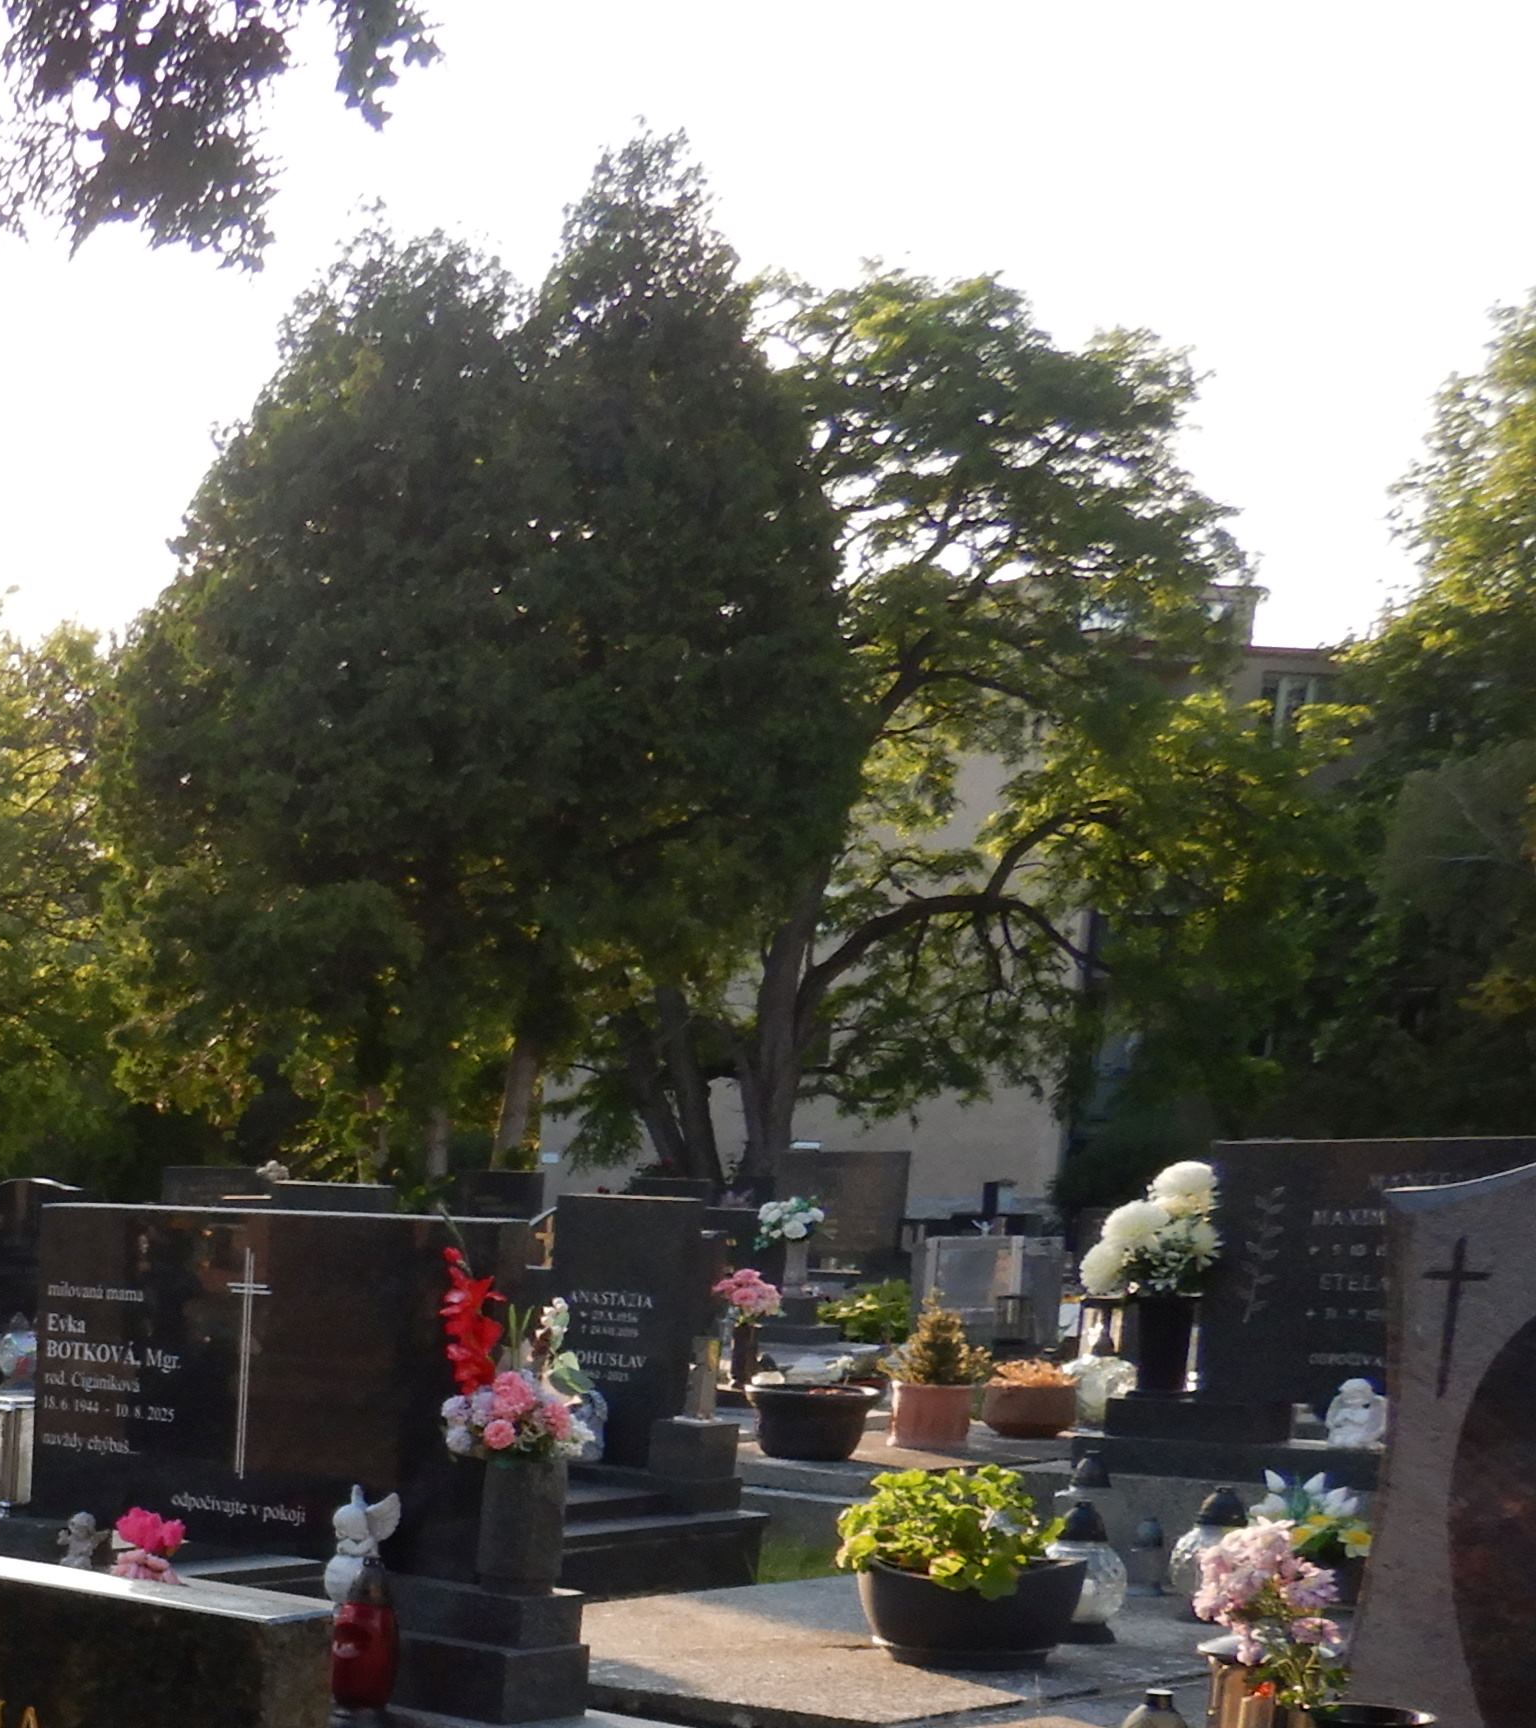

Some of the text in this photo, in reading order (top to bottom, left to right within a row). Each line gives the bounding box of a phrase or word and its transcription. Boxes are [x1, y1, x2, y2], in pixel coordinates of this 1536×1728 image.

[106, 1287, 144, 1302] mama
[47, 1313, 87, 1334] Evka
[146, 1348, 182, 1373] Mgr.
[575, 1350, 648, 1368] OHUSLAV
[74, 1398, 100, 1414] 1944
[147, 1405, 176, 1423] 2025
[170, 1491, 248, 1518] odpočívajte
[261, 1503, 306, 1527] pokoji
